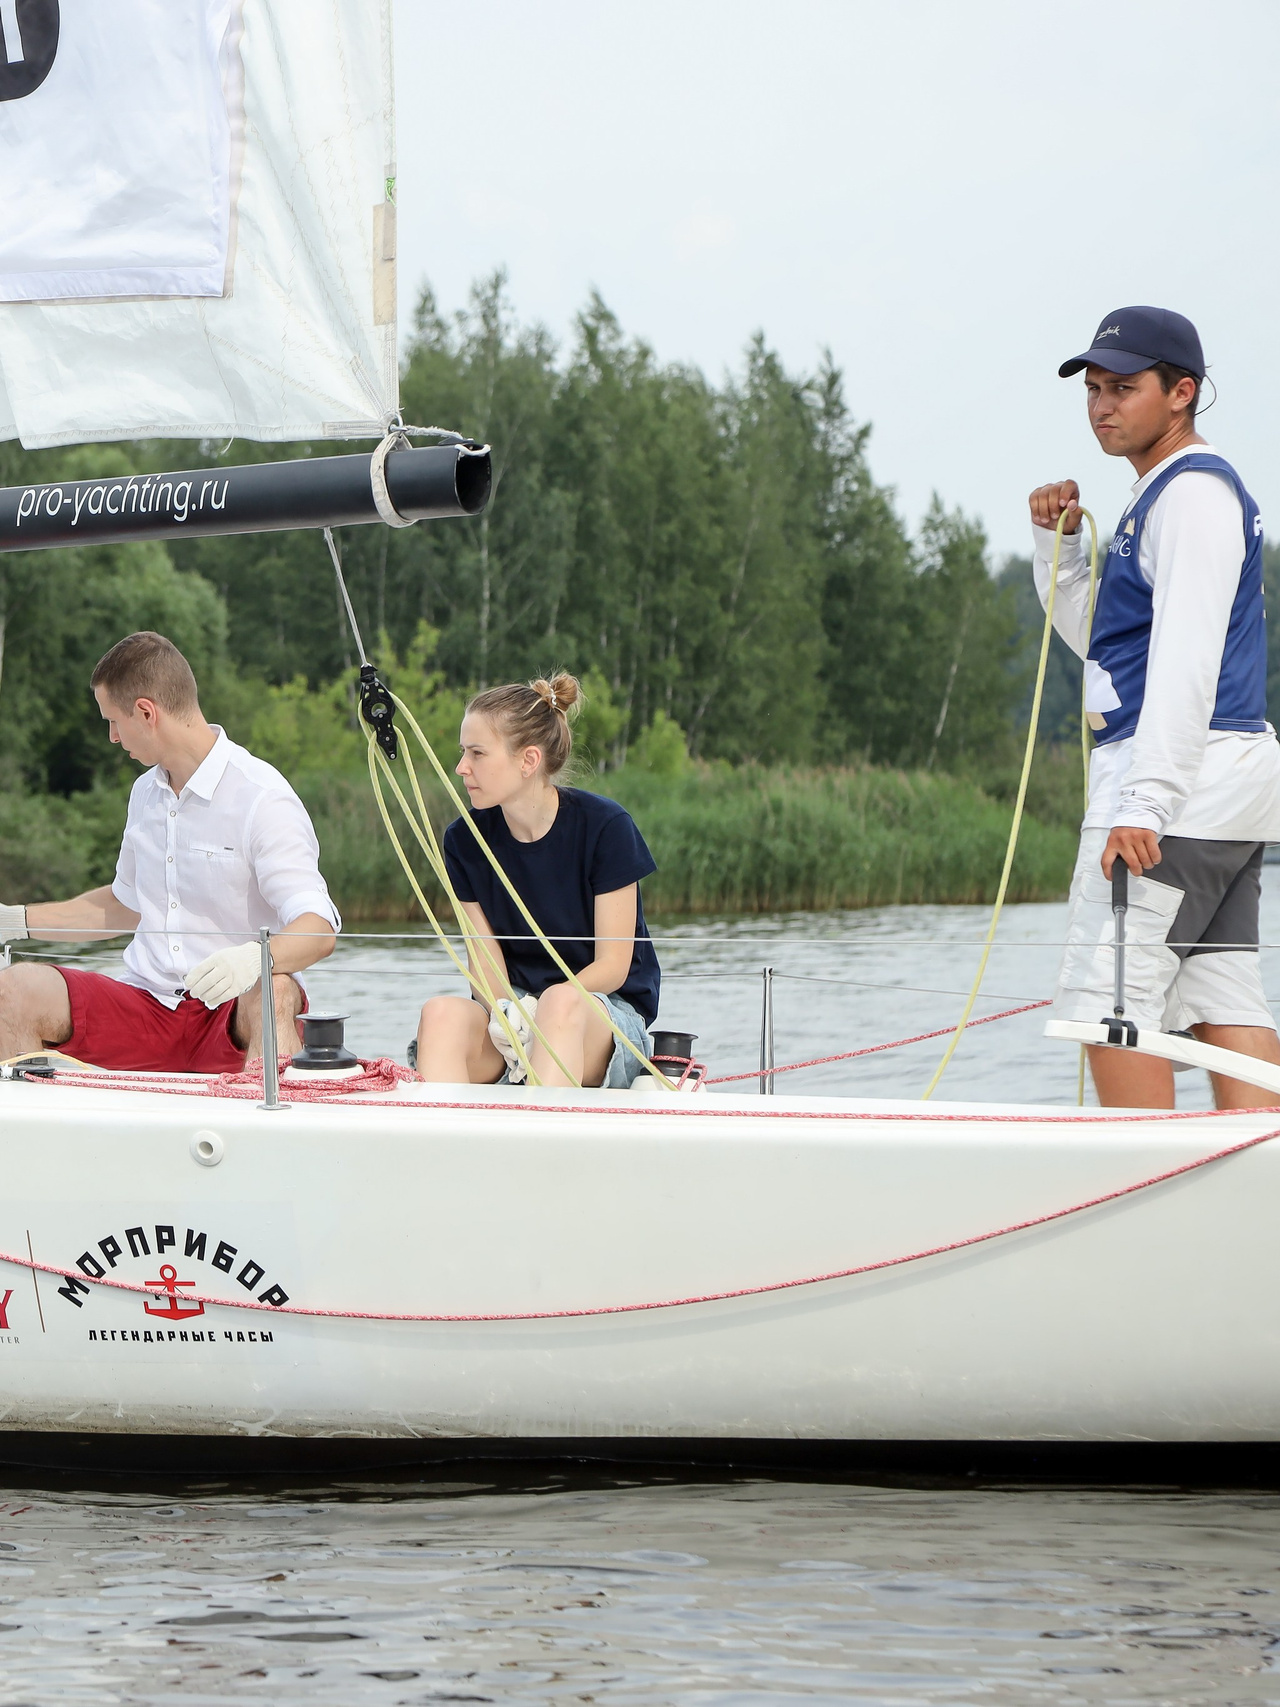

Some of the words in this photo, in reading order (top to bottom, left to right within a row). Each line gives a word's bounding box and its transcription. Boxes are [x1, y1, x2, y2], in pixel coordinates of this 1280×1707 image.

[16, 475, 229, 527] pro-yachting.ru
[57, 1225, 290, 1309] МОРПРИБОР
[88, 1330, 216, 1343] ЛЕГЕНДАРНЫЕ
[224, 1331, 274, 1342] ЧАСЫ
